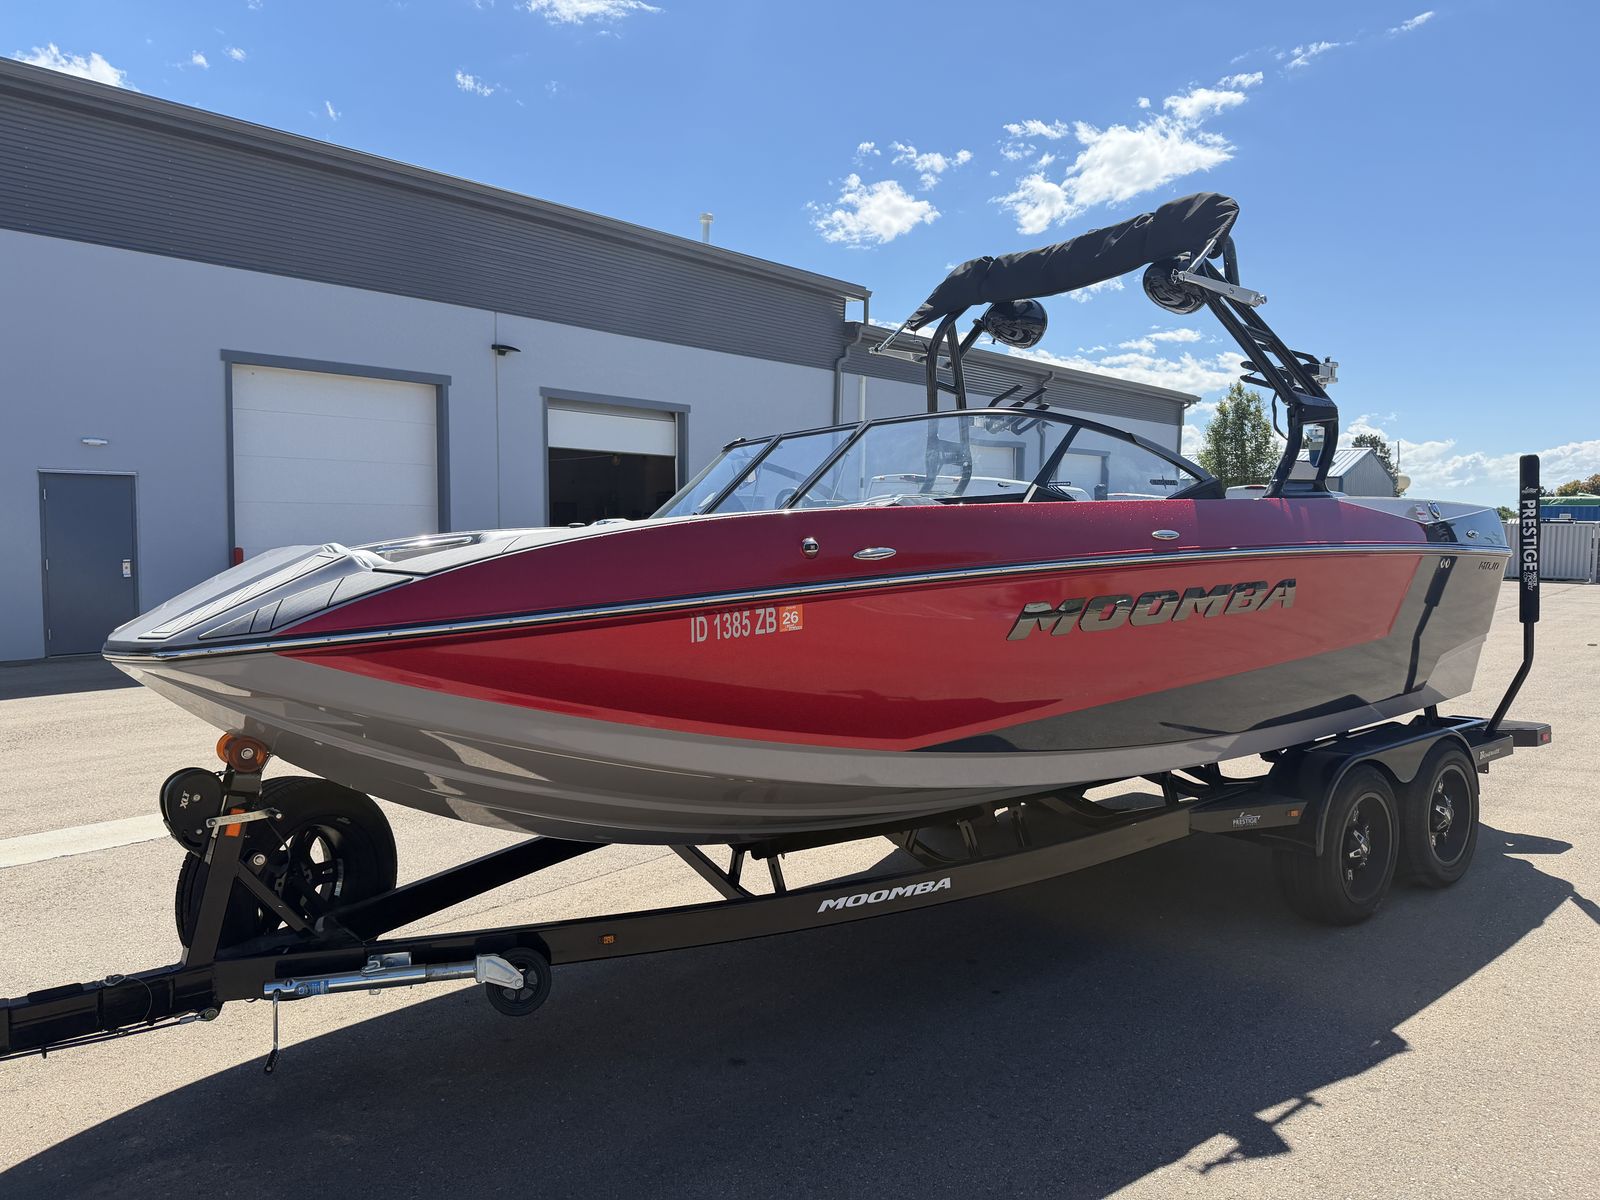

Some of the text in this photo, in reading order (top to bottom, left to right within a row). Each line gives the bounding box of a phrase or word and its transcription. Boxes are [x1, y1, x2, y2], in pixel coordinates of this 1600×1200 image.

[1522, 500, 1538, 571] PRESTIGE
[690, 607, 777, 643] ID 1385 ZB
[782, 611, 799, 625] 26
[1006, 578, 1297, 641] MOOMBA
[180, 790, 190, 809] XLT
[816, 877, 951, 914] MOOMBA
